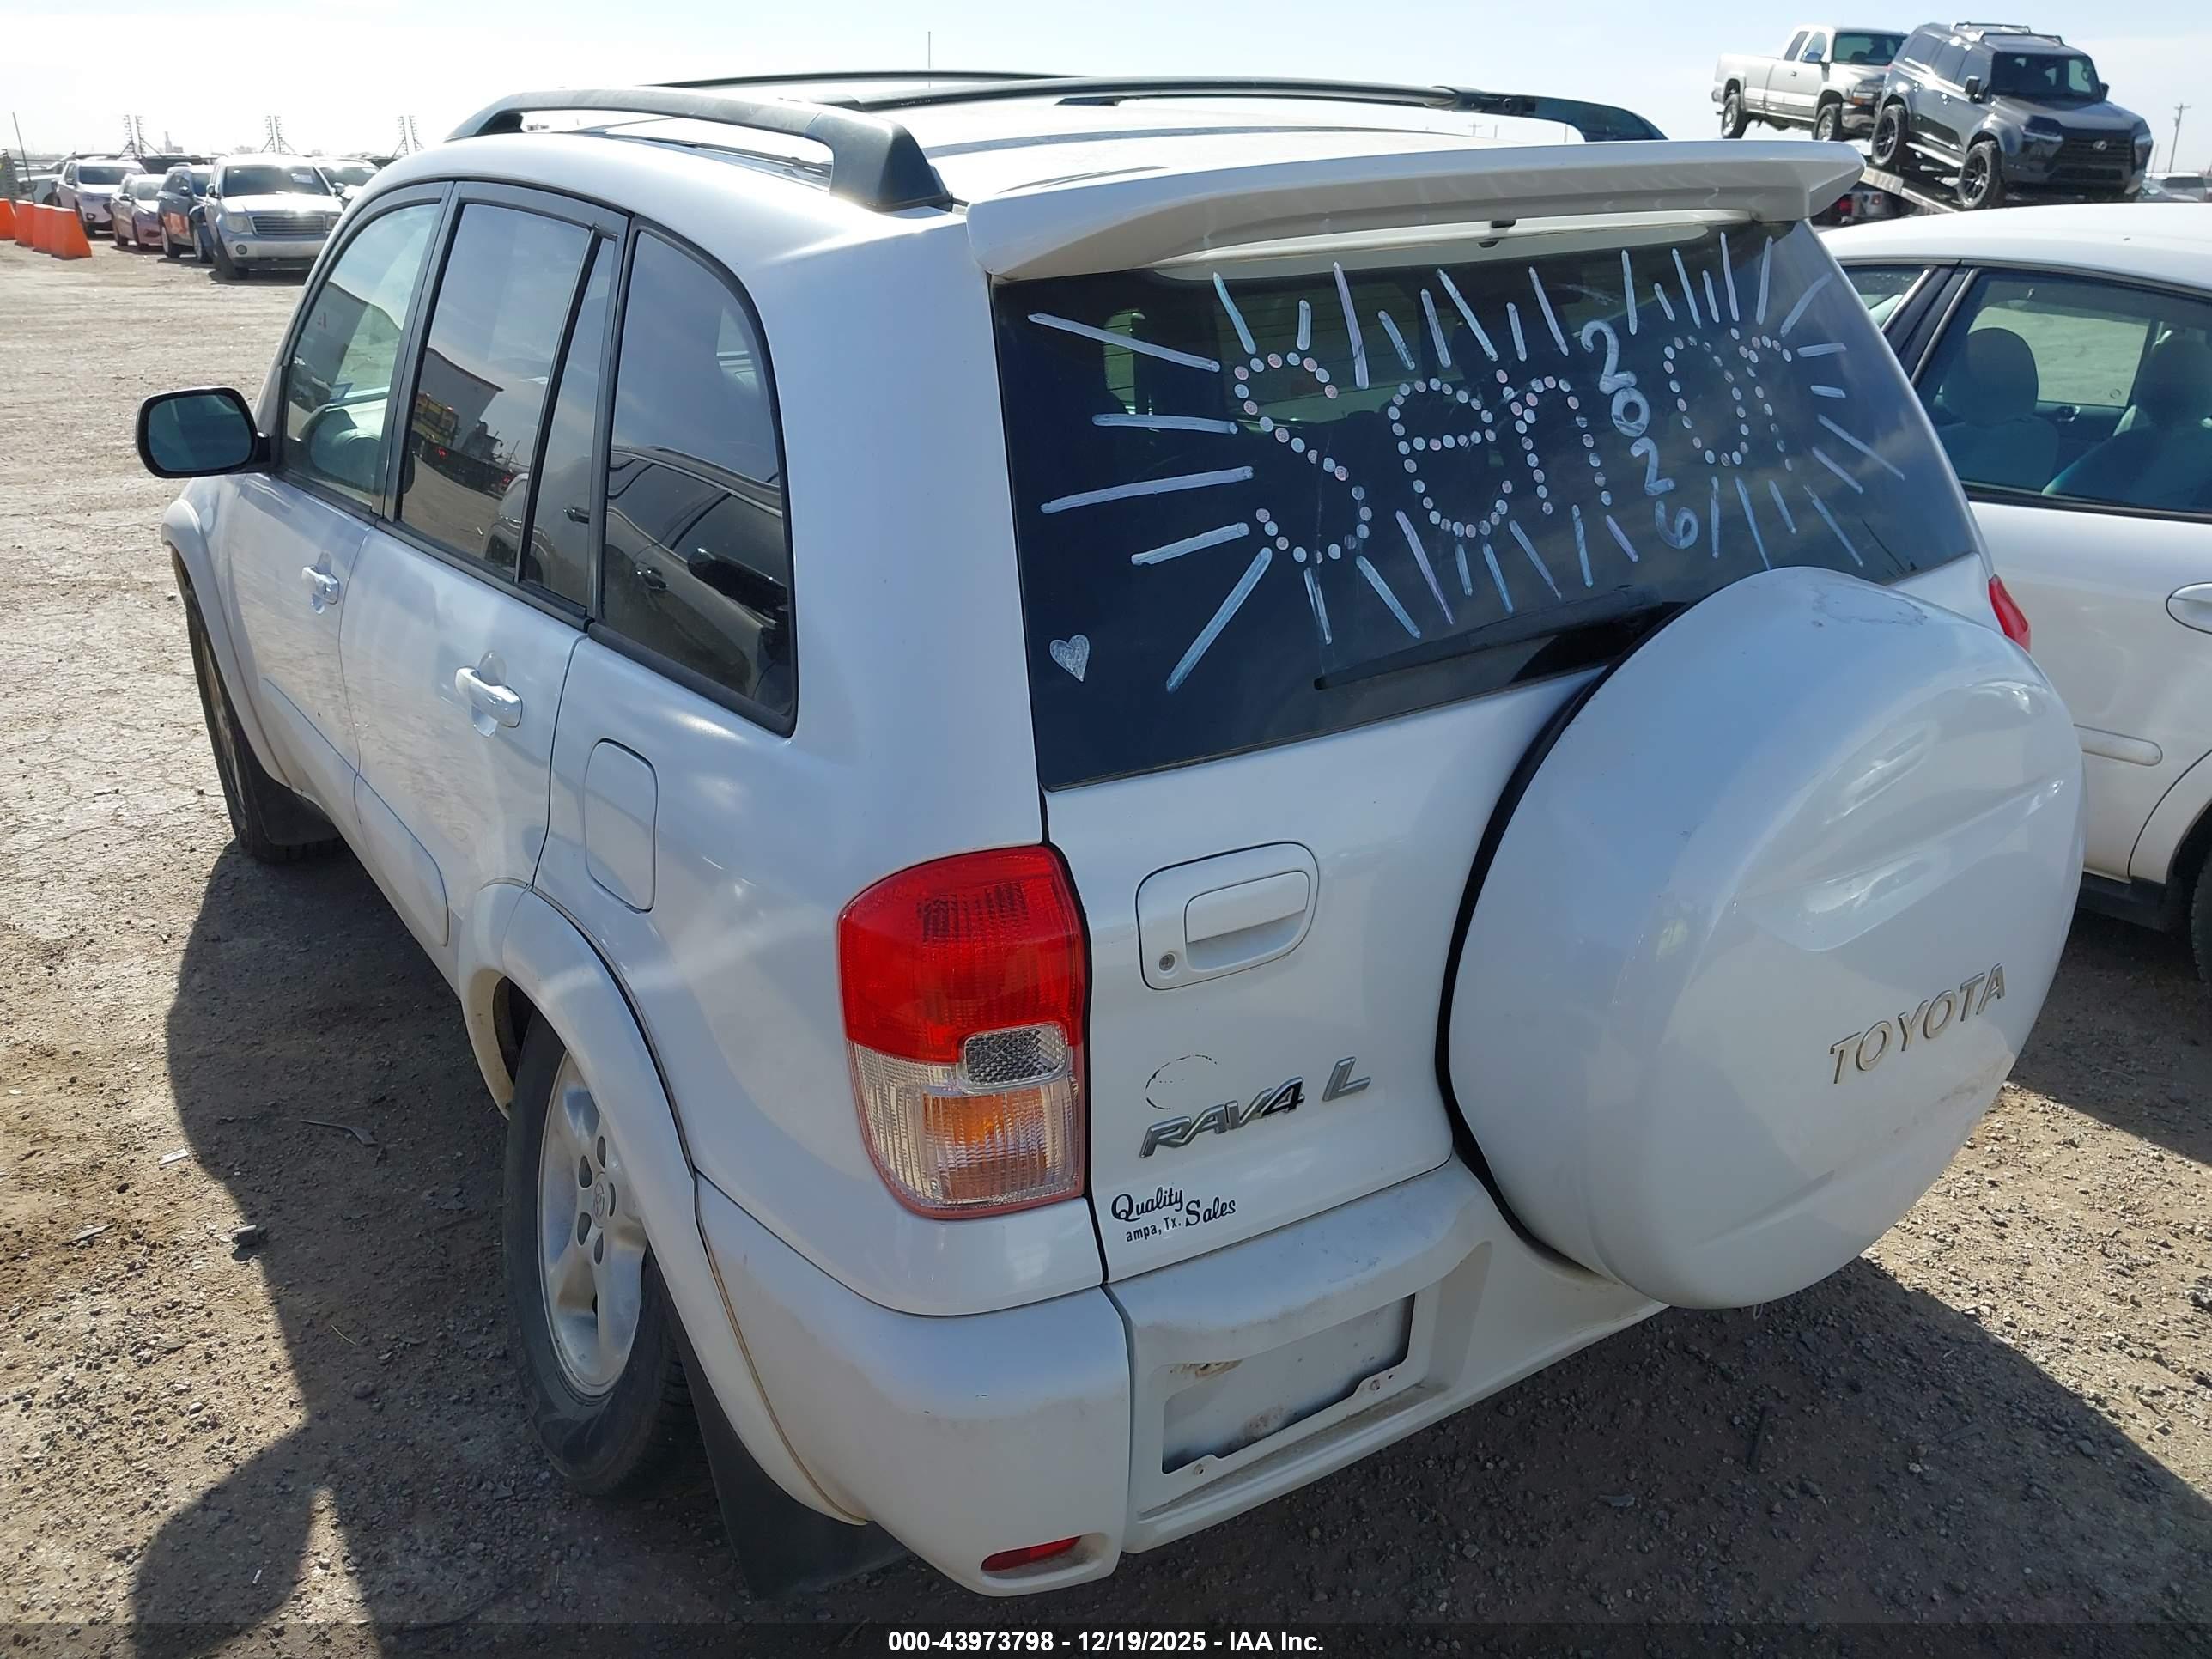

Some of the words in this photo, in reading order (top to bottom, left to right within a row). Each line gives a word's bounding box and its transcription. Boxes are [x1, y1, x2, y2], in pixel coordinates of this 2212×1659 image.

[1580, 319, 1699, 550] 2026
[1829, 962, 2007, 1085] TOYOTA
[1139, 1075, 1305, 1158] RAV4
[1322, 1055, 1372, 1103] L
[1110, 1186, 1184, 1223] Quality
[1185, 1196, 1237, 1228] Sales
[1163, 1216, 1182, 1231] Tx.
